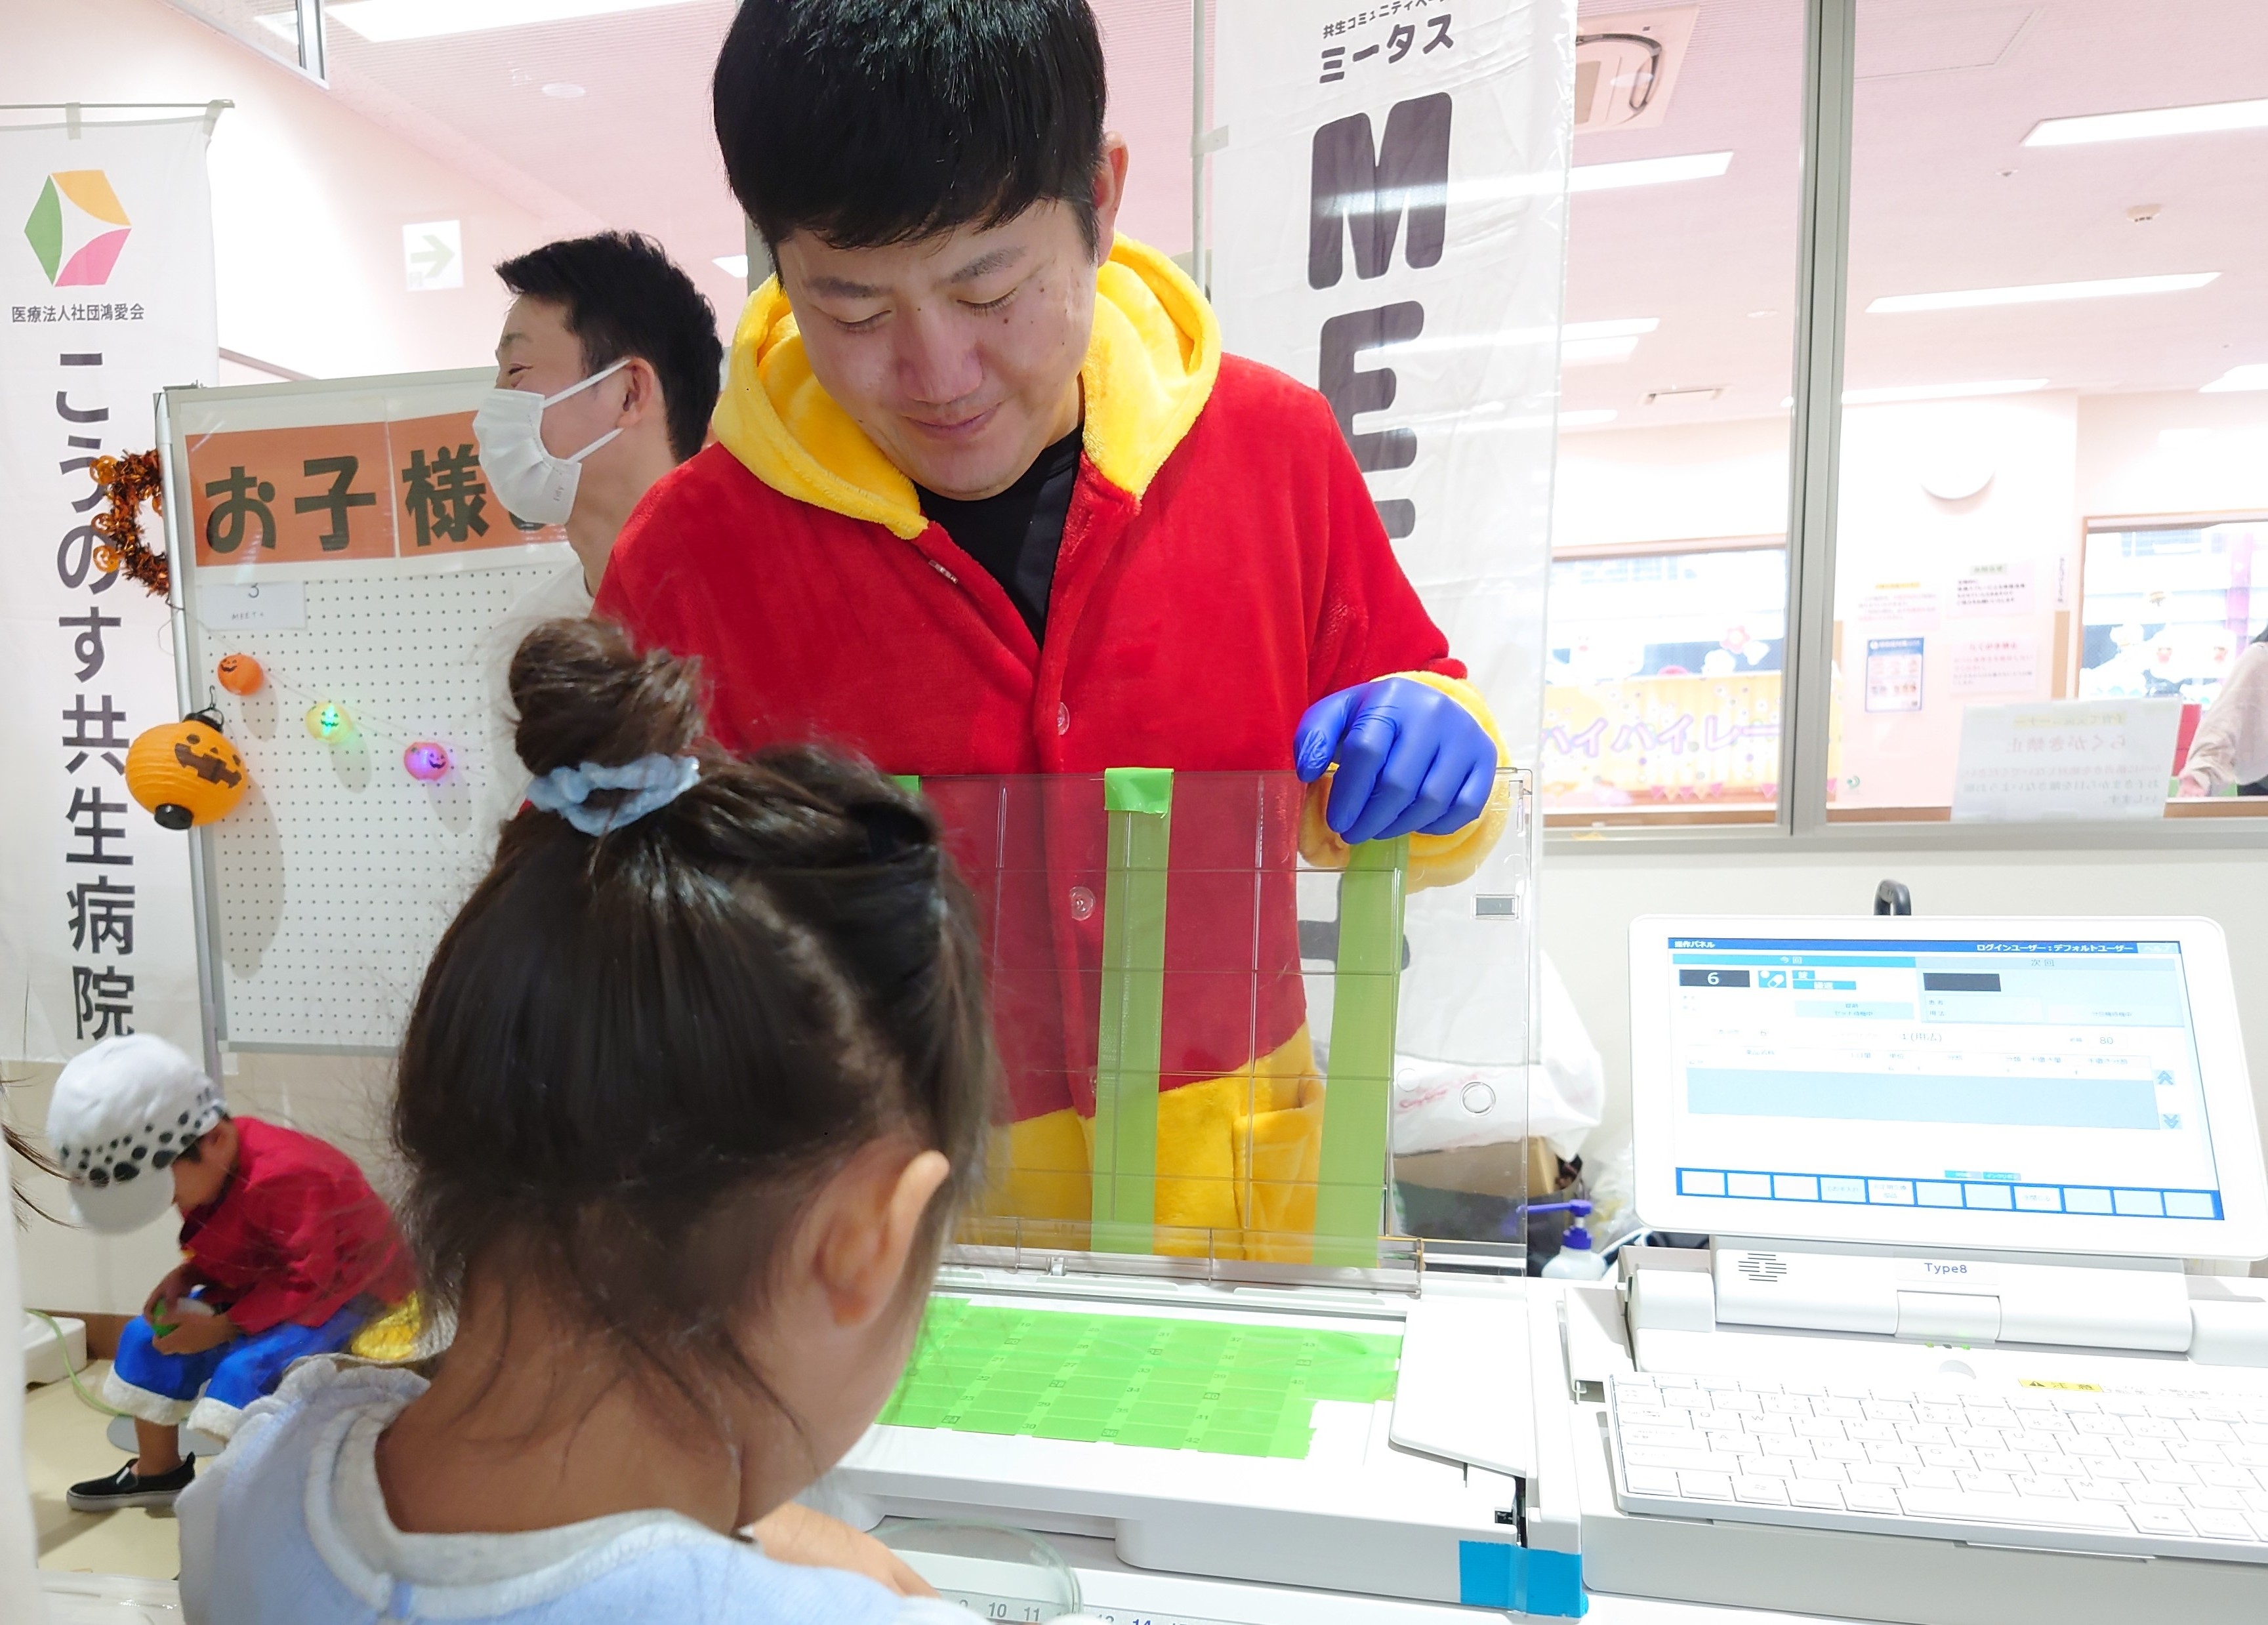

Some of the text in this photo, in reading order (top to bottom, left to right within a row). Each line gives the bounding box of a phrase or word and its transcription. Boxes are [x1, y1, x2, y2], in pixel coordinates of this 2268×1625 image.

[1319, 14, 1454, 83] ミータス
[11, 302, 145, 323] 医療法人社団鴻愛会
[205, 443, 546, 552] お子様
[56, 352, 135, 1040] こうのす共生病院
[1707, 972, 1720, 985] 6
[2099, 1036, 2114, 1044] 80
[1923, 1262, 1968, 1275] Type8
[988, 1602, 1007, 1618] 10
[1023, 1607, 1041, 1622] 11
